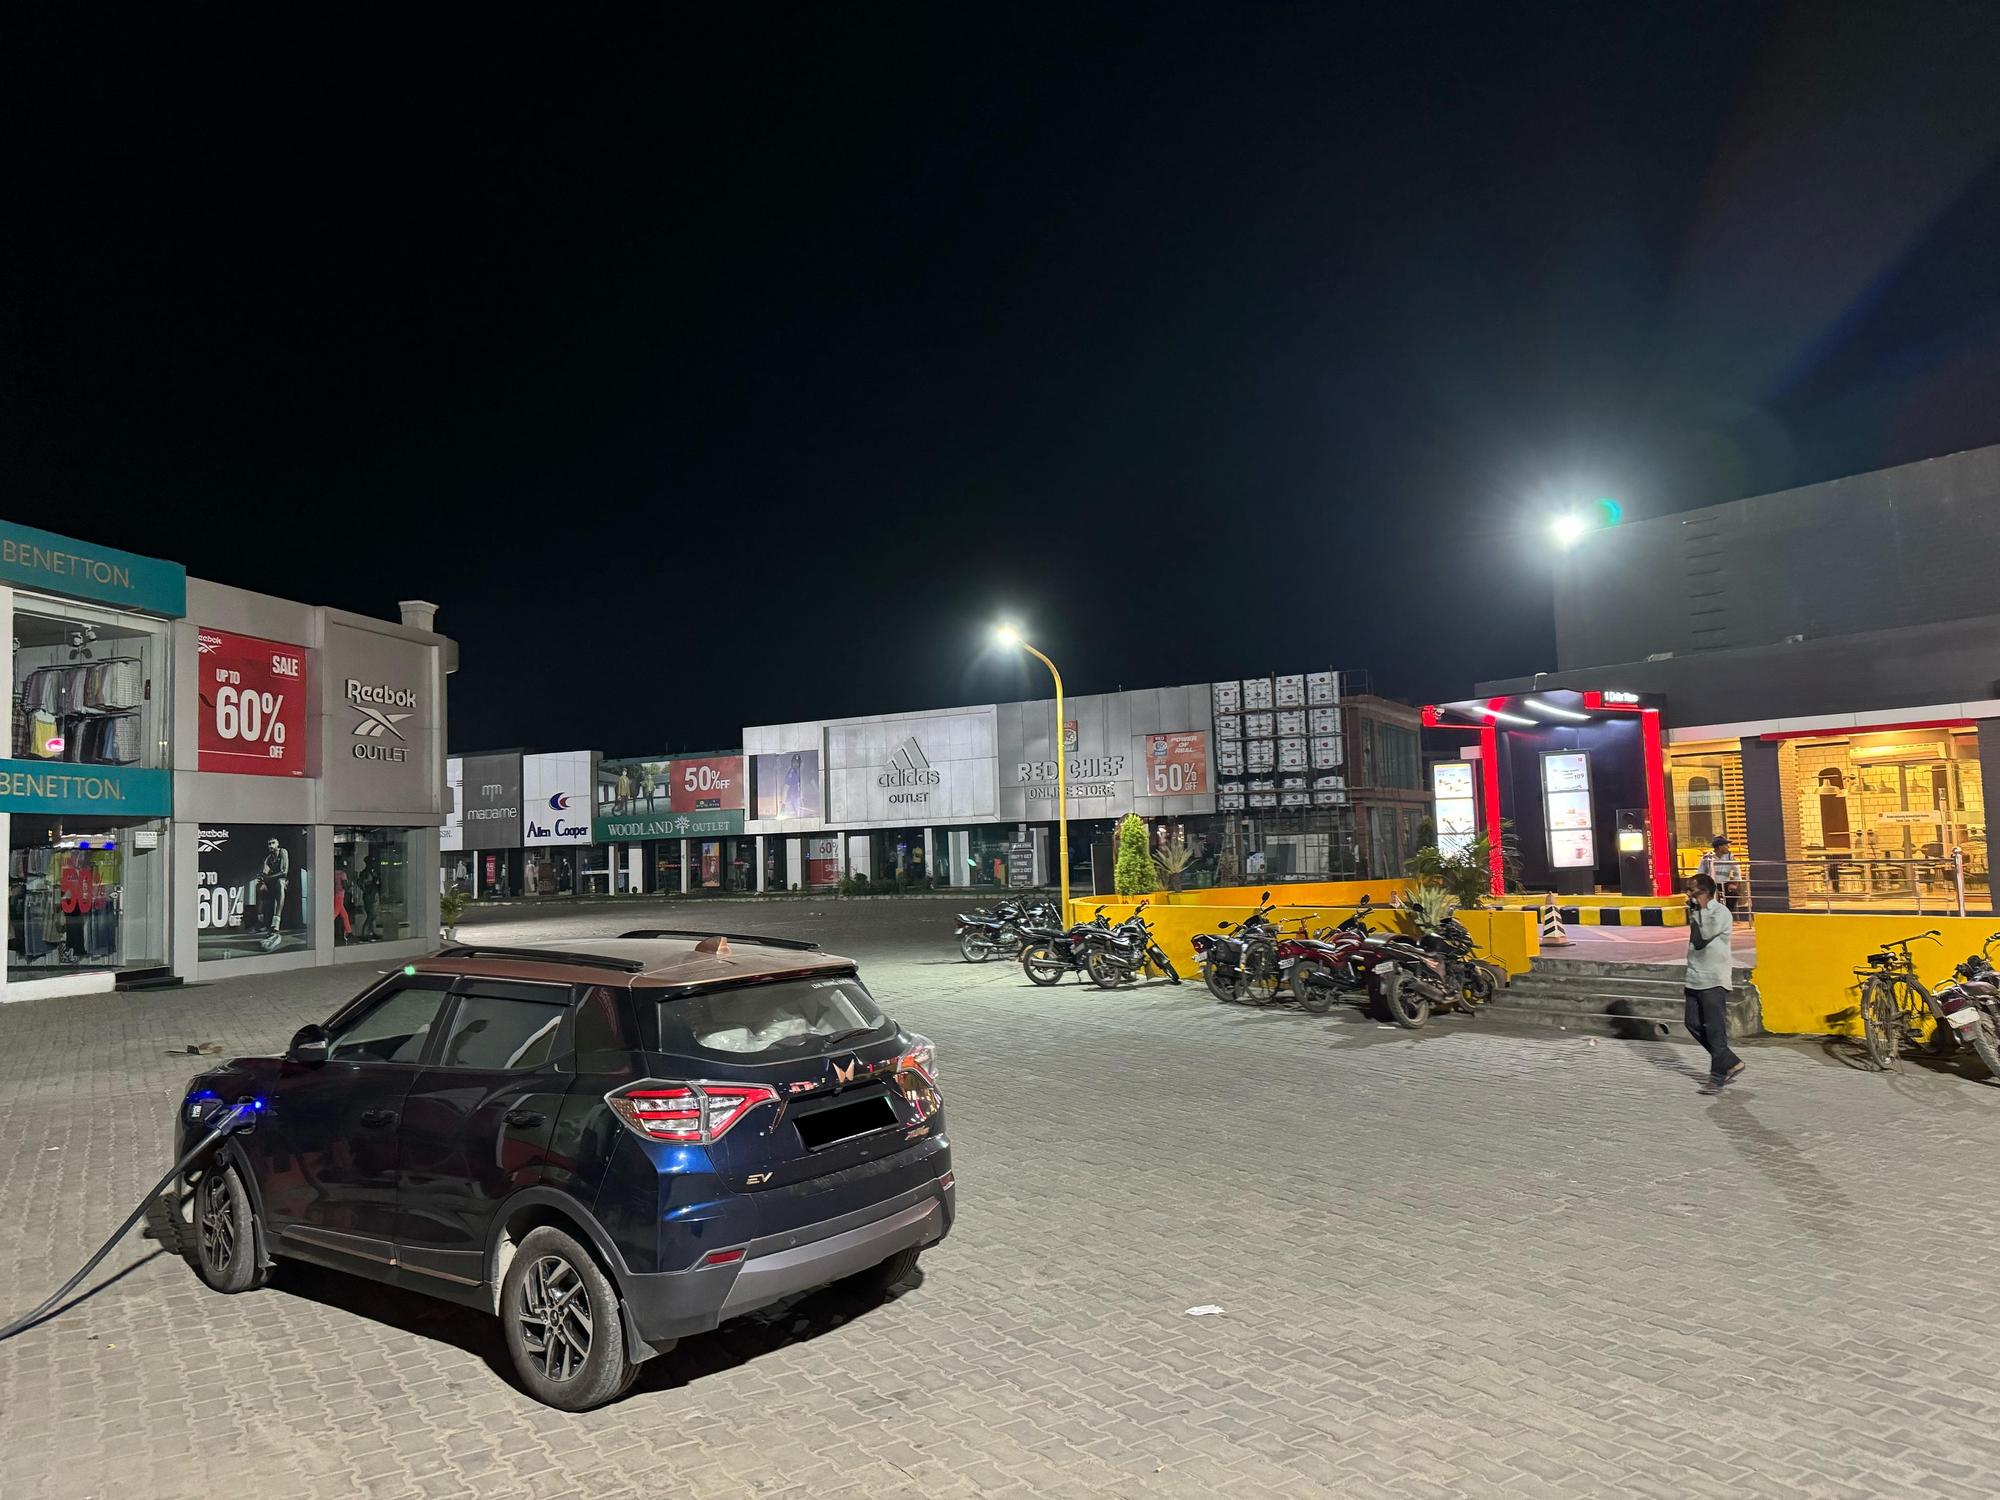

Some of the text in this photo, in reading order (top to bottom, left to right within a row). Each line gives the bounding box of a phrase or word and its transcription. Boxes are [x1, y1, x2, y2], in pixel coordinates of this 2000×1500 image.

[3, 540, 136, 590] BENETTON.
[198, 634, 223, 645] eebok
[272, 655, 298, 676] SALE
[216, 668, 240, 685] UP TO
[345, 679, 417, 708] Reebok
[216, 686, 286, 743] 60%
[269, 746, 285, 759] OFF
[353, 744, 411, 762] OUTLET
[1018, 756, 1124, 782] RED CHIEF
[1154, 763, 1197, 792] 50%
[0, 772, 126, 800] BENETTON.
[684, 766, 730, 792] 50% OFF
[878, 769, 940, 788] adidas
[1185, 781, 1199, 791] OFF
[888, 792, 929, 804] OUTLET
[1076, 782, 1115, 797] STORE
[467, 807, 517, 820] madame
[526, 819, 589, 839] Allen Cooper
[607, 821, 730, 836] WOODLAND OUTLET
[198, 871, 218, 885] P TO
[198, 886, 245, 929] 60%
[229, 914, 244, 926] OFF
[746, 1172, 773, 1185] EV
